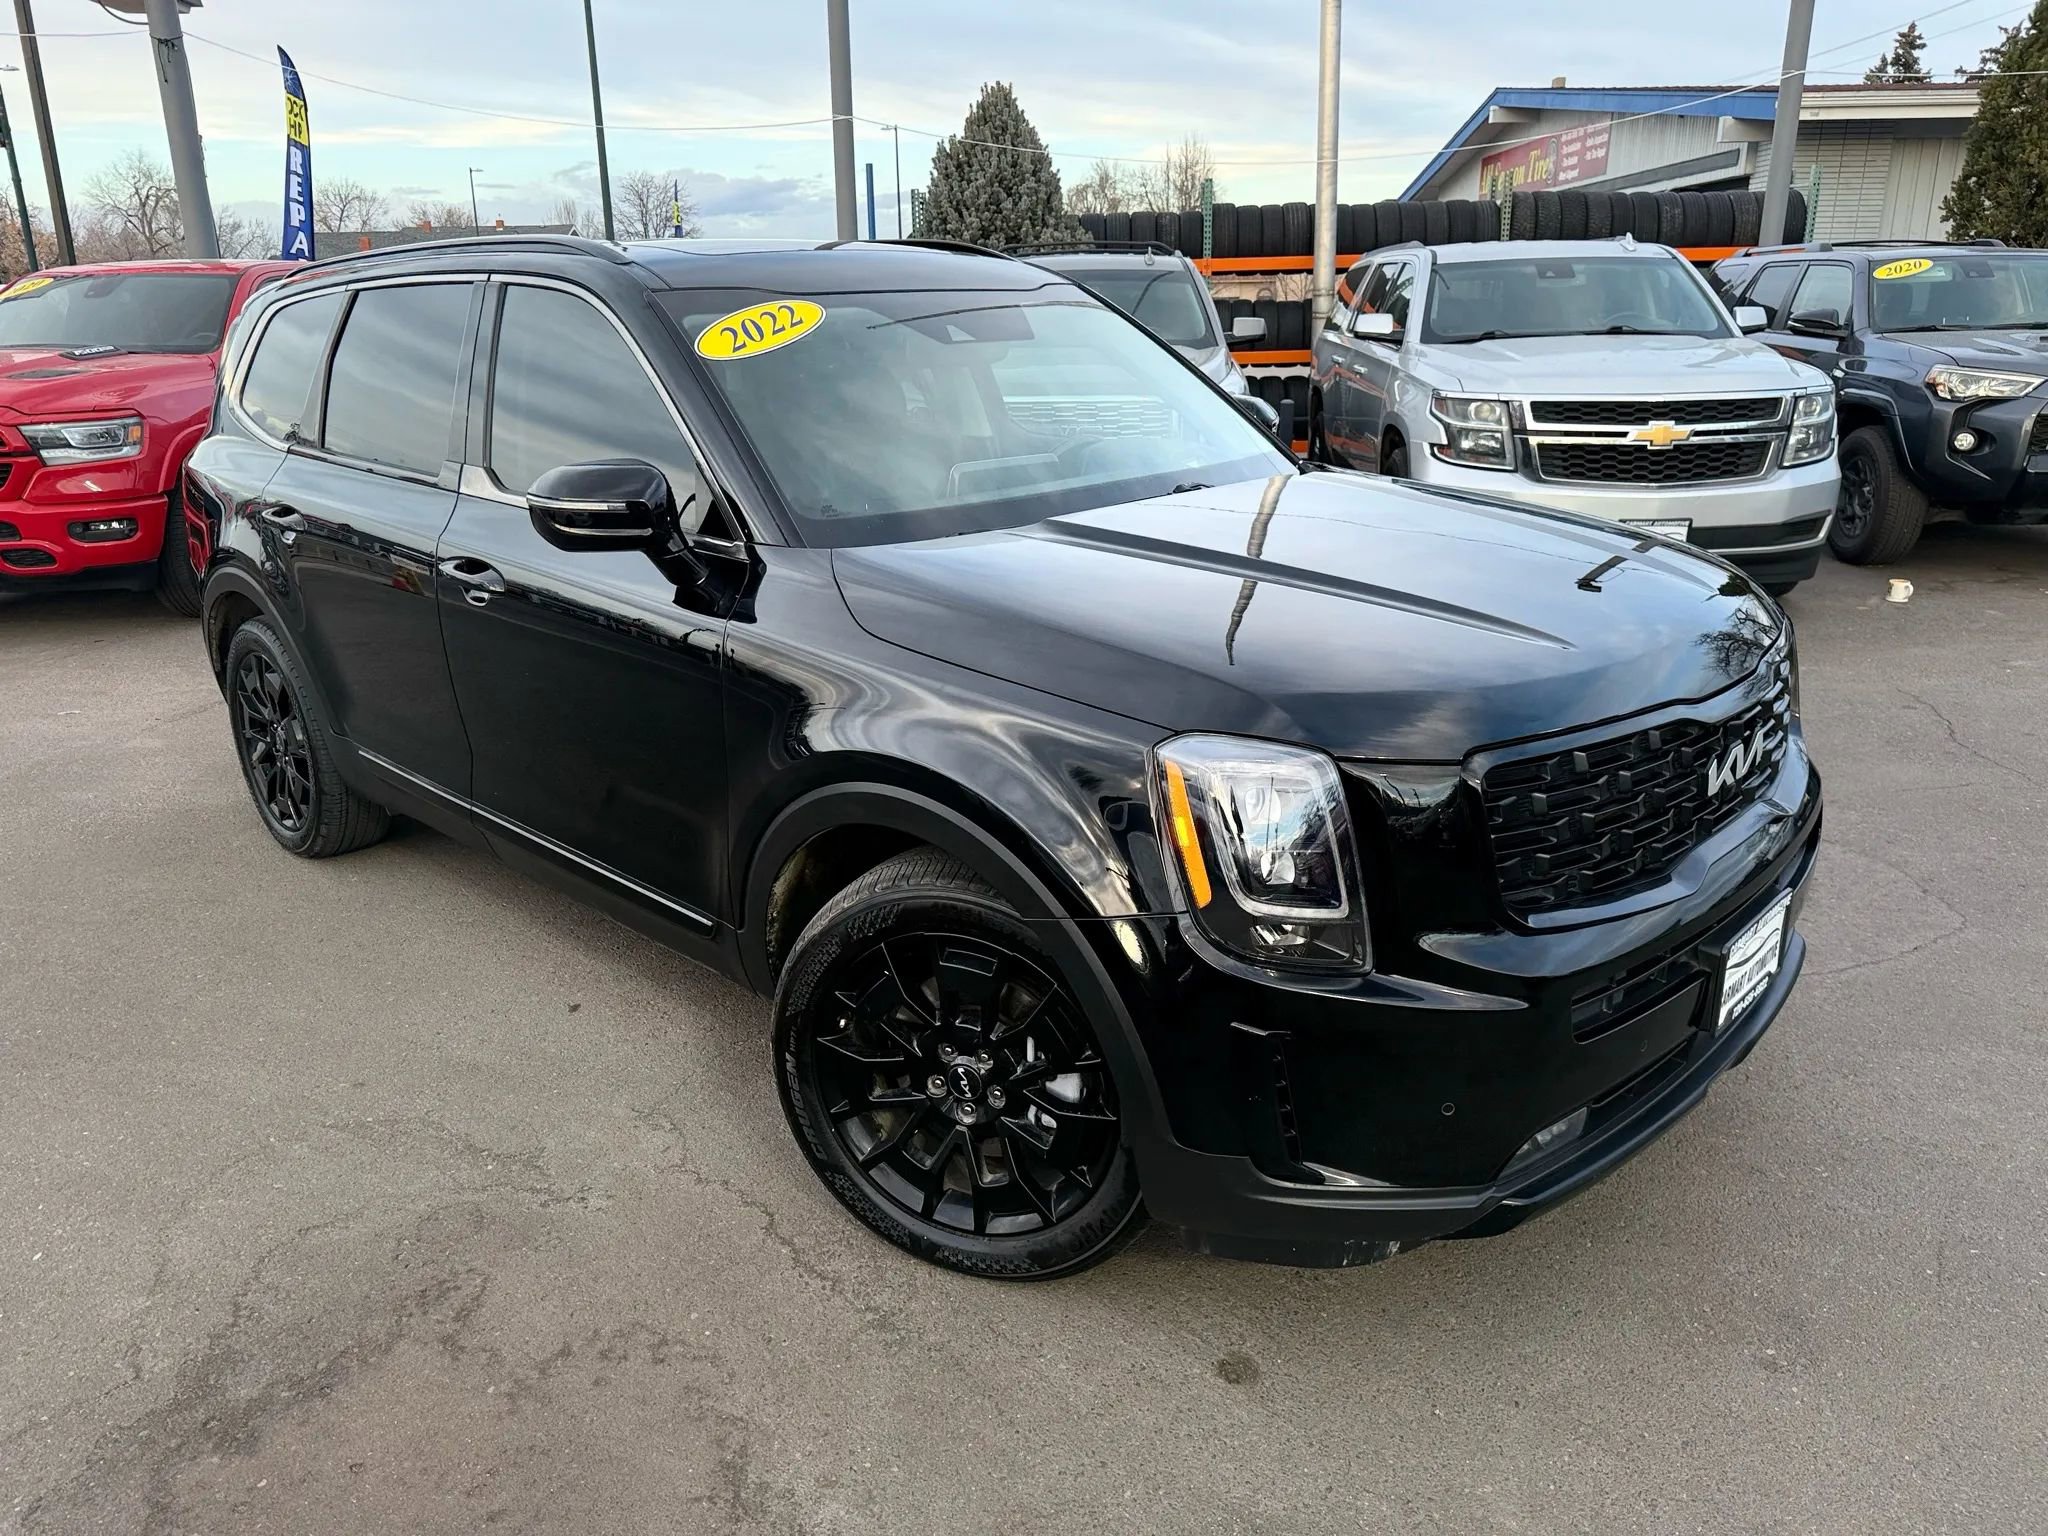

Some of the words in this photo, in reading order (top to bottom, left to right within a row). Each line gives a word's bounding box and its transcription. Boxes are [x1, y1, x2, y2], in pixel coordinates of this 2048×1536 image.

[1494, 161, 1526, 190] Seon
[288, 146, 309, 261] REPA
[1885, 260, 1922, 277] 2020
[719, 304, 804, 353] 2022
[1721, 970, 1748, 1006] ARMART
[785, 1051, 828, 1161] CRUGEN
